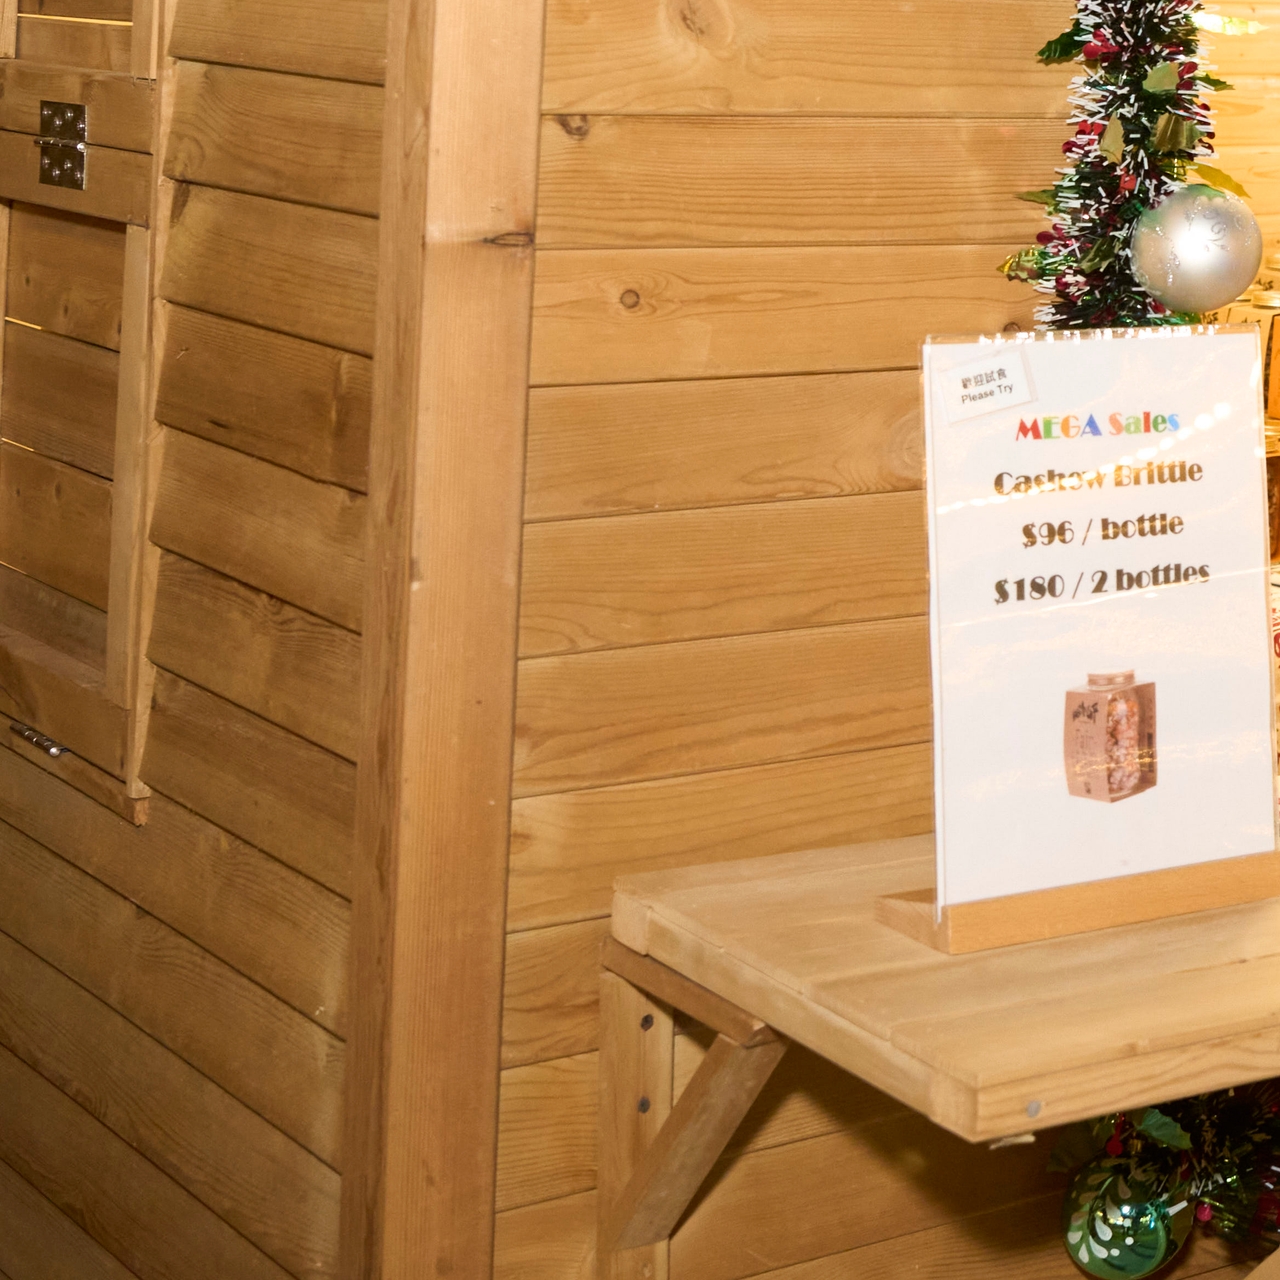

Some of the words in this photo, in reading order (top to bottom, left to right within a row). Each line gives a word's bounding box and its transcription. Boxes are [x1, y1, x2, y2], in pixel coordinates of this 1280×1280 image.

[962, 390, 994, 404] Please
[997, 384, 1013, 393] Try
[1016, 414, 1102, 441] MEGA
[1108, 412, 1180, 436] Sales
[994, 470, 1108, 495] Cashew
[1114, 461, 1203, 487] Brittle
[1022, 520, 1074, 548] $96
[1082, 519, 1092, 545] /
[1101, 513, 1184, 540] bottle
[995, 574, 1064, 605] $180
[1072, 572, 1084, 599] /
[1092, 570, 1108, 593] 2
[1116, 564, 1210, 591] bottles
